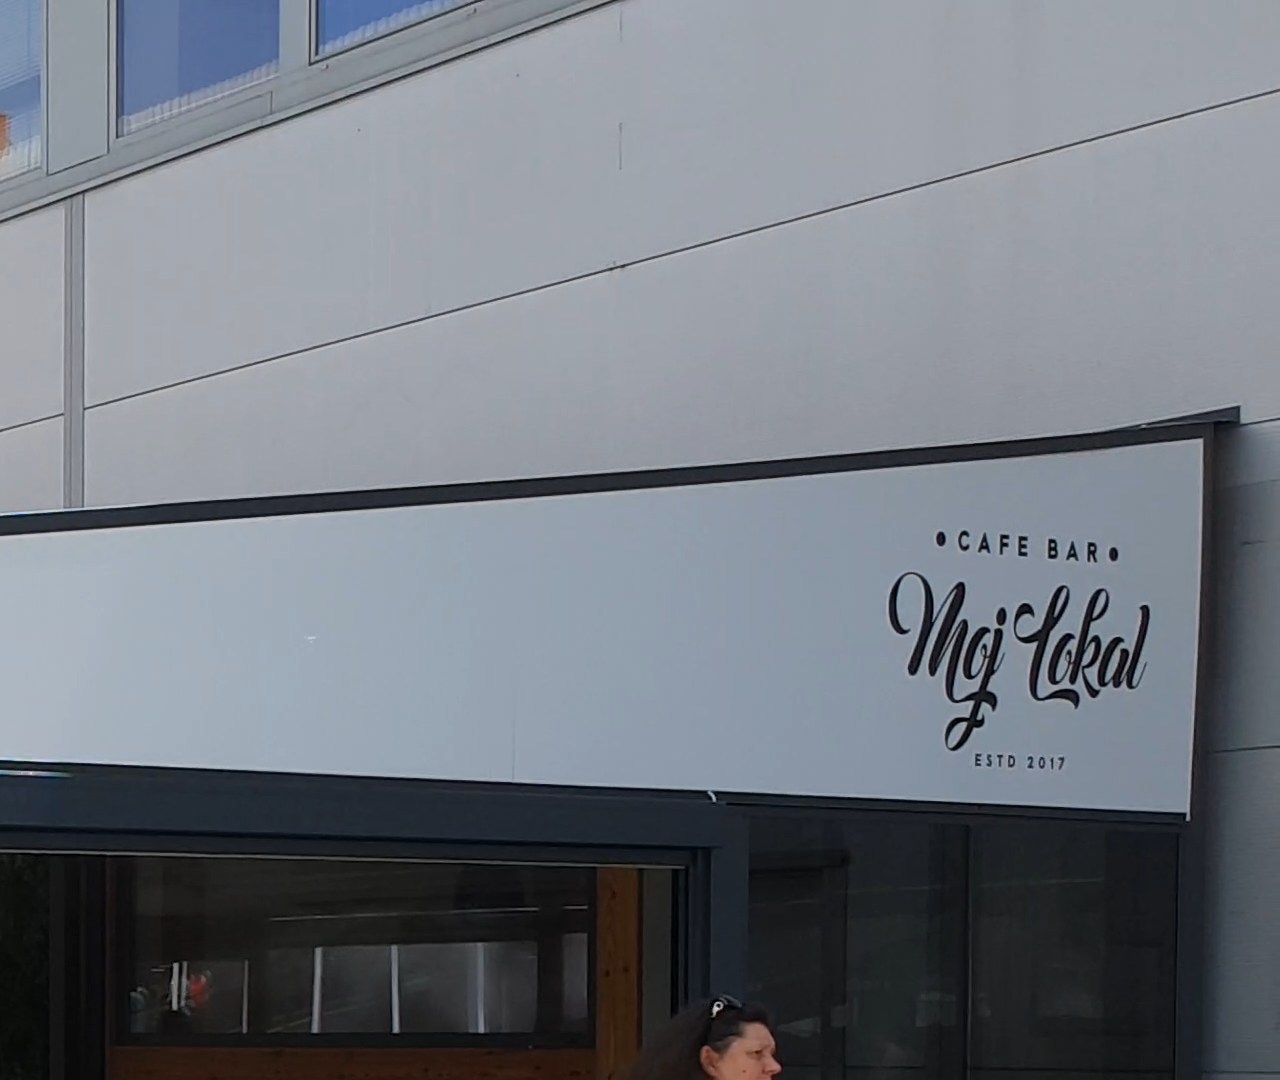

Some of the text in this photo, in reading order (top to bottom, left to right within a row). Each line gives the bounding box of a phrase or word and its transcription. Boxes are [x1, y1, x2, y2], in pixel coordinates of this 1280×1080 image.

[957, 529, 1099, 564] CAFE BAR
[888, 571, 1007, 752] Moj
[974, 753, 1066, 771] ESTD 2017
